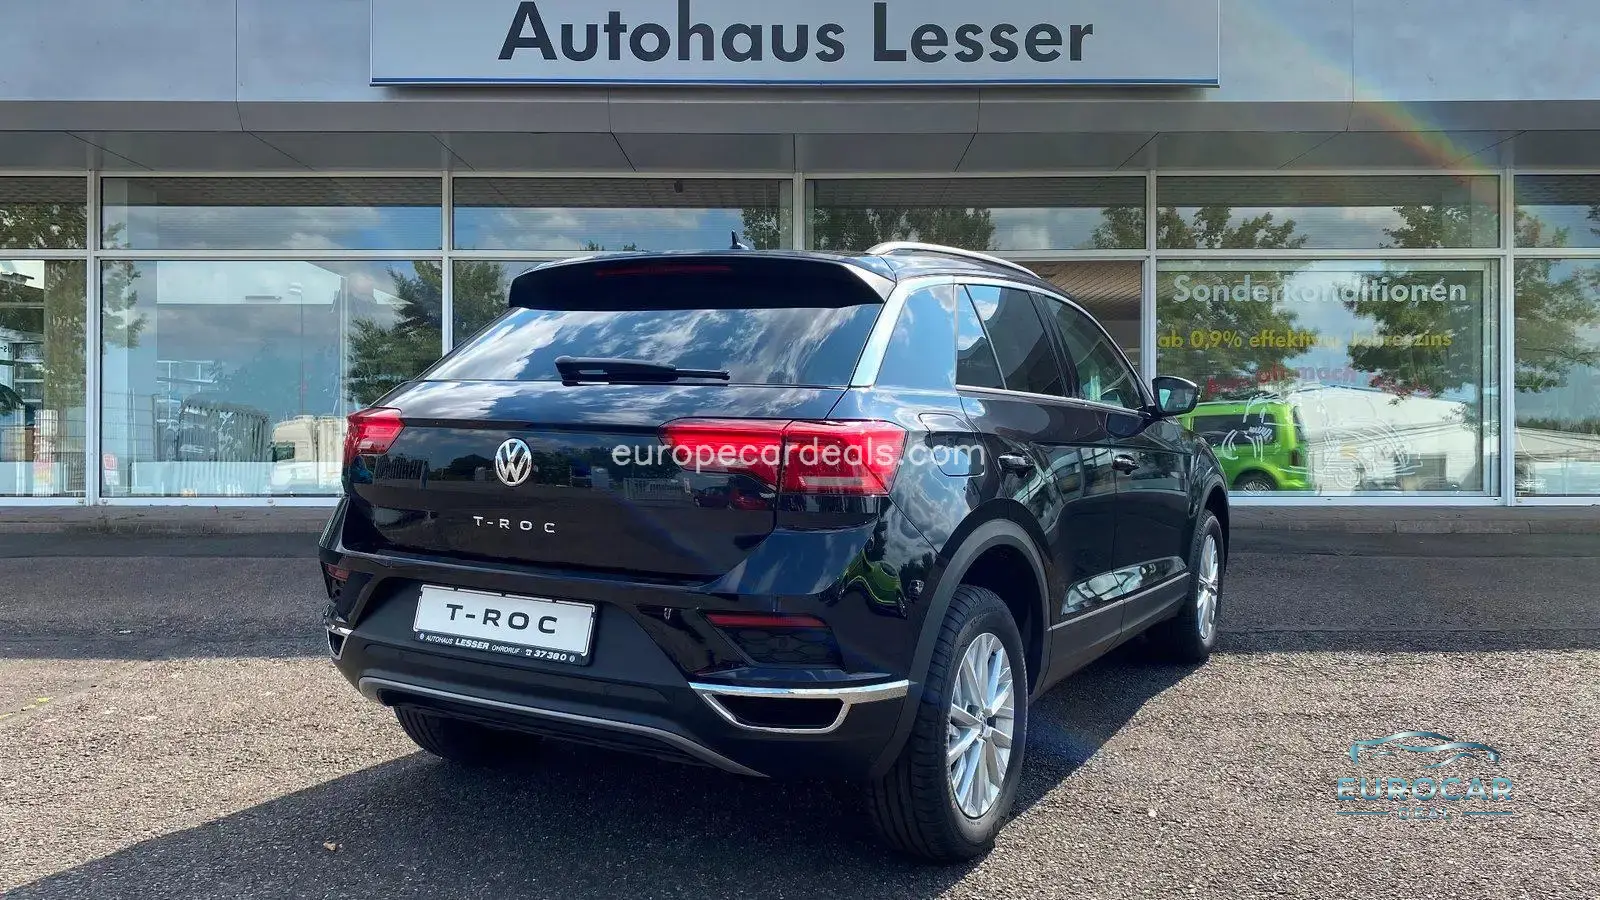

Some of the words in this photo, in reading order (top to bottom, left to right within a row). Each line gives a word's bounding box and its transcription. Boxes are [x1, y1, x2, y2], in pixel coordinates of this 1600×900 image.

[498, 0, 846, 63] Autohaus
[873, 2, 1094, 63] Lesser
[1172, 274, 1467, 303] Sonderkonditionen
[1158, 330, 1184, 348] ab
[1190, 329, 1243, 350] 0,9%
[473, 515, 556, 533] T-ROC
[446, 603, 558, 634] T-ROC
[425, 634, 453, 645] AUTOHAUS
[455, 638, 489, 650] LESSER
[533, 650, 567, 662] 37380
